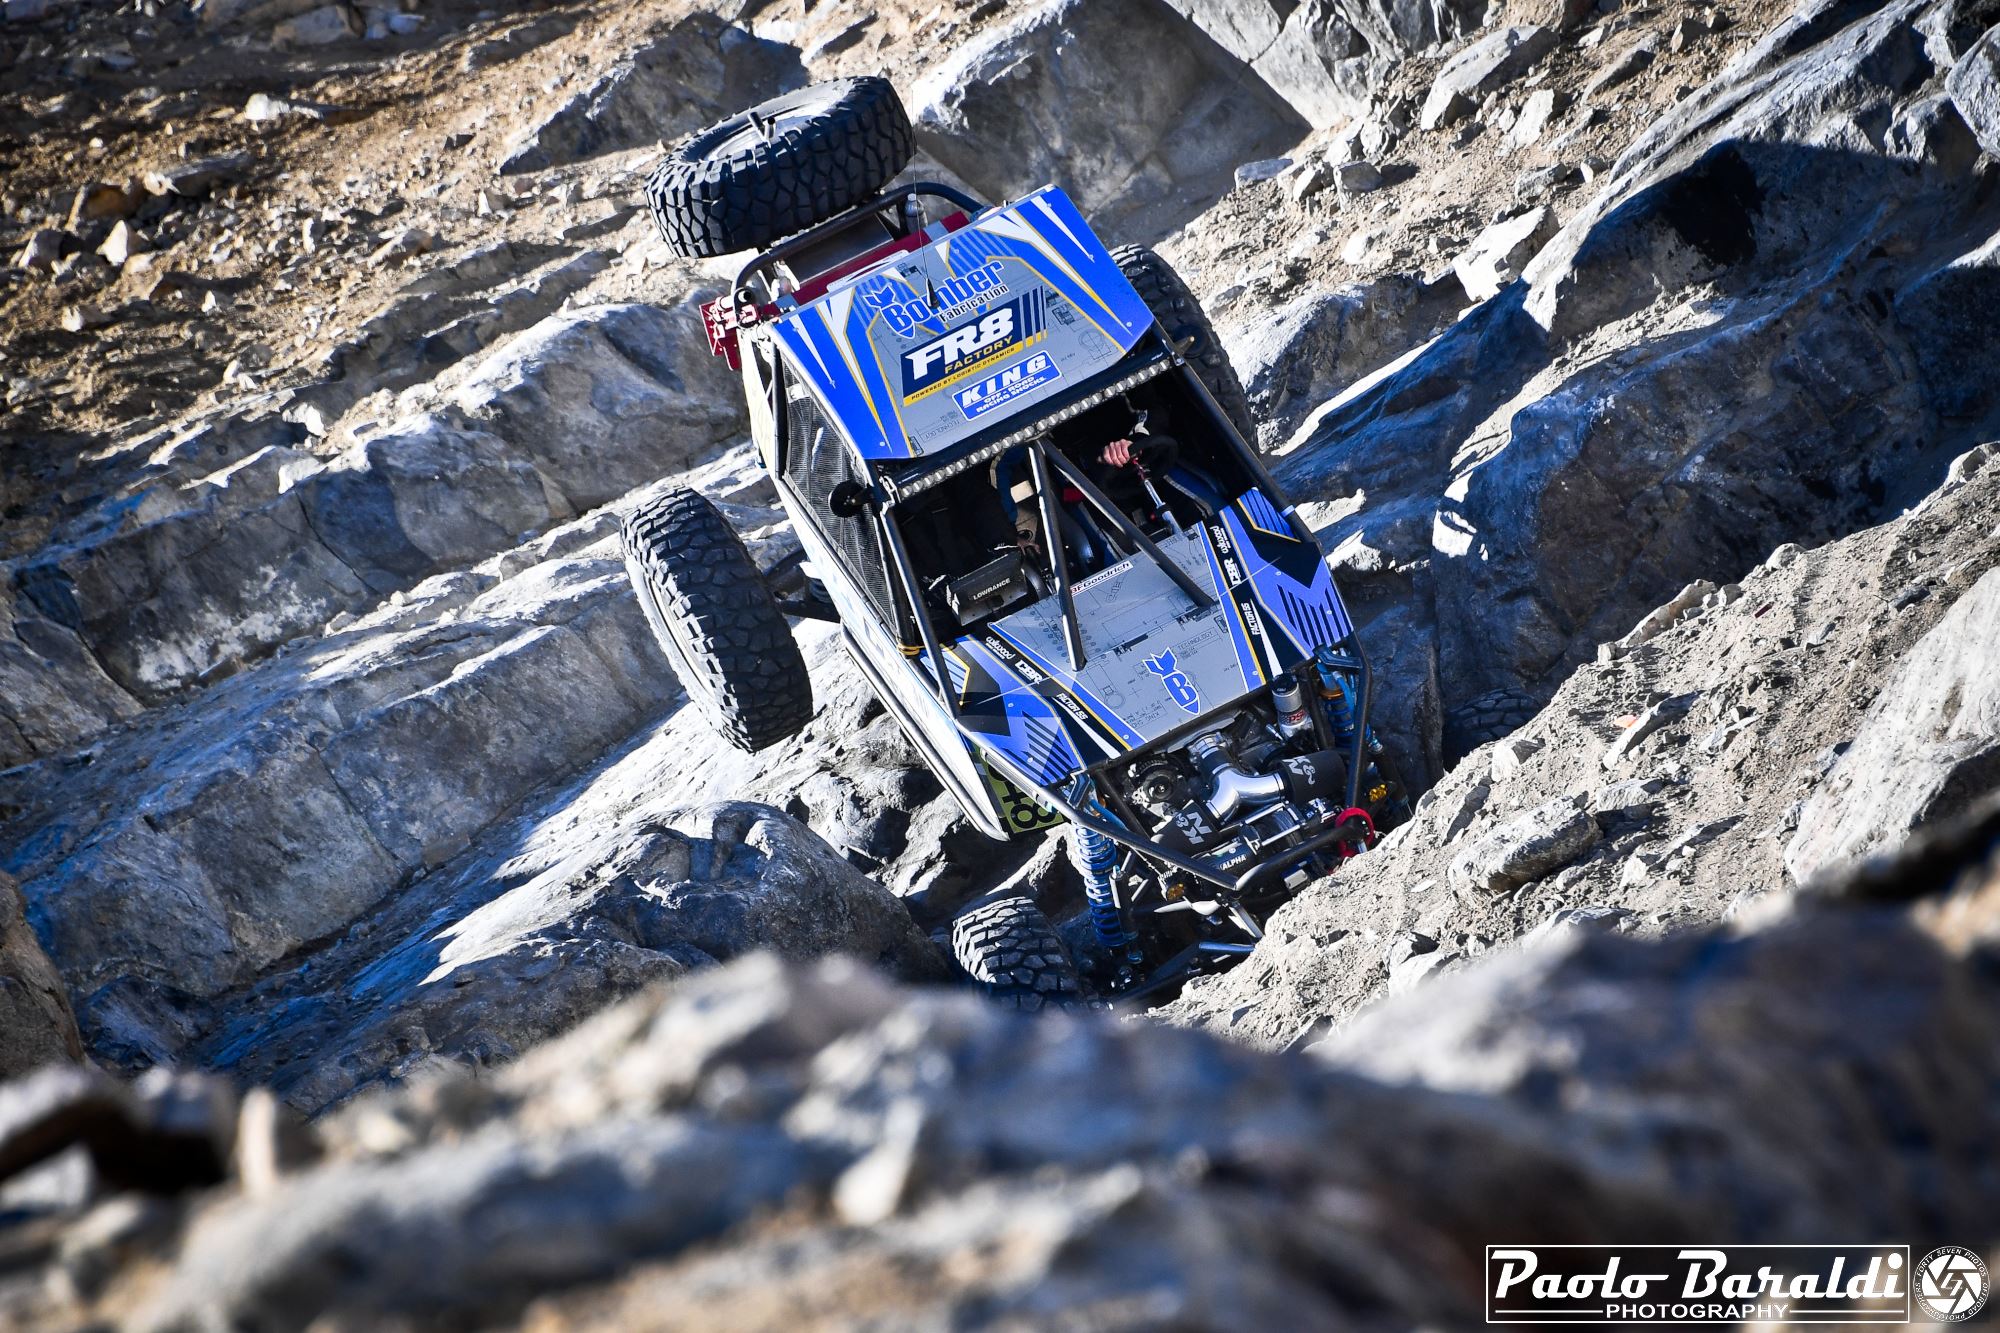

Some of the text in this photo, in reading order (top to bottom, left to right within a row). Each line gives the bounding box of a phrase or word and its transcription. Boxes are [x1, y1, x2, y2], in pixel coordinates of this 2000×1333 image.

[880, 260, 1004, 335] Bomber
[938, 284, 1009, 323] Fabrication
[905, 308, 1014, 380] FR8
[944, 335, 1014, 374] FACTORY
[911, 382, 942, 400] POWERED
[982, 347, 1015, 365] DYNAMICS
[962, 355, 1046, 407] KING
[976, 394, 1010, 413] RACING
[1224, 557, 1241, 586] CBR
[973, 577, 1011, 601] LOWRANCE
[1245, 610, 1261, 636] FACTOR
[985, 636, 1016, 660] wilwood
[1014, 659, 1043, 685] CBR
[1056, 692, 1080, 713] FACTOR
